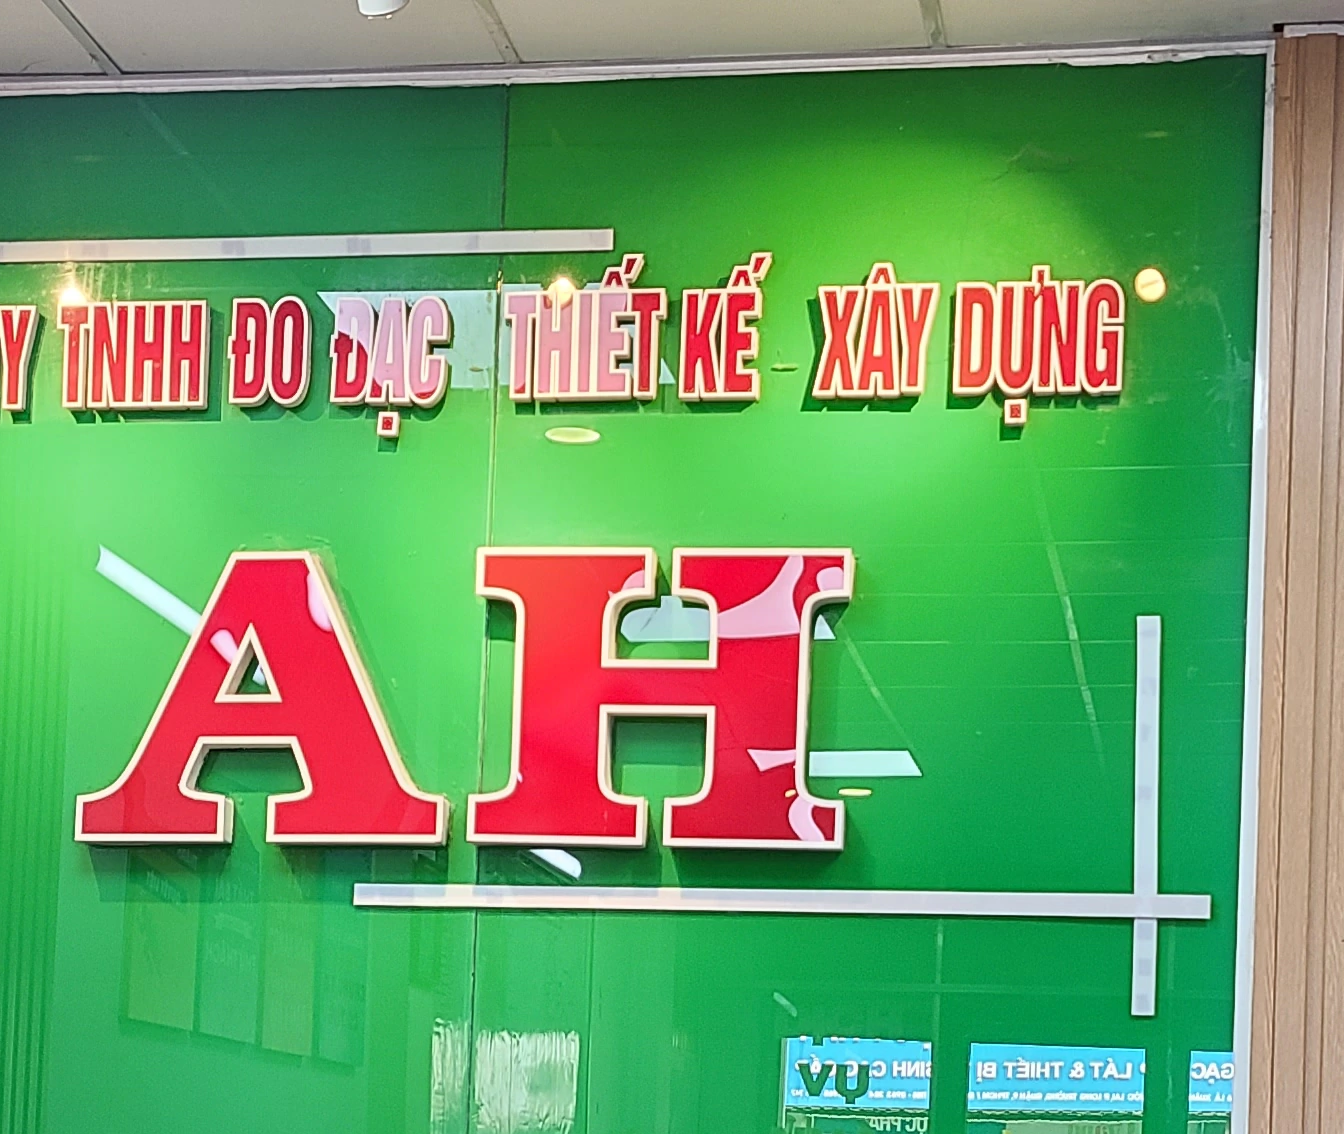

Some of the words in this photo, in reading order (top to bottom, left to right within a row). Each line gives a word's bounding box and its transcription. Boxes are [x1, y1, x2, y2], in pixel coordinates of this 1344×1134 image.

[57, 300, 208, 410] TNHH
[228, 296, 312, 407] ĐO
[330, 295, 450, 438] ĐẠC
[505, 253, 666, 400] THIẾT
[679, 252, 773, 400] KẾ
[812, 262, 940, 399] XÂY
[952, 265, 1125, 426] DỰNG
[74, 546, 855, 851] AH
